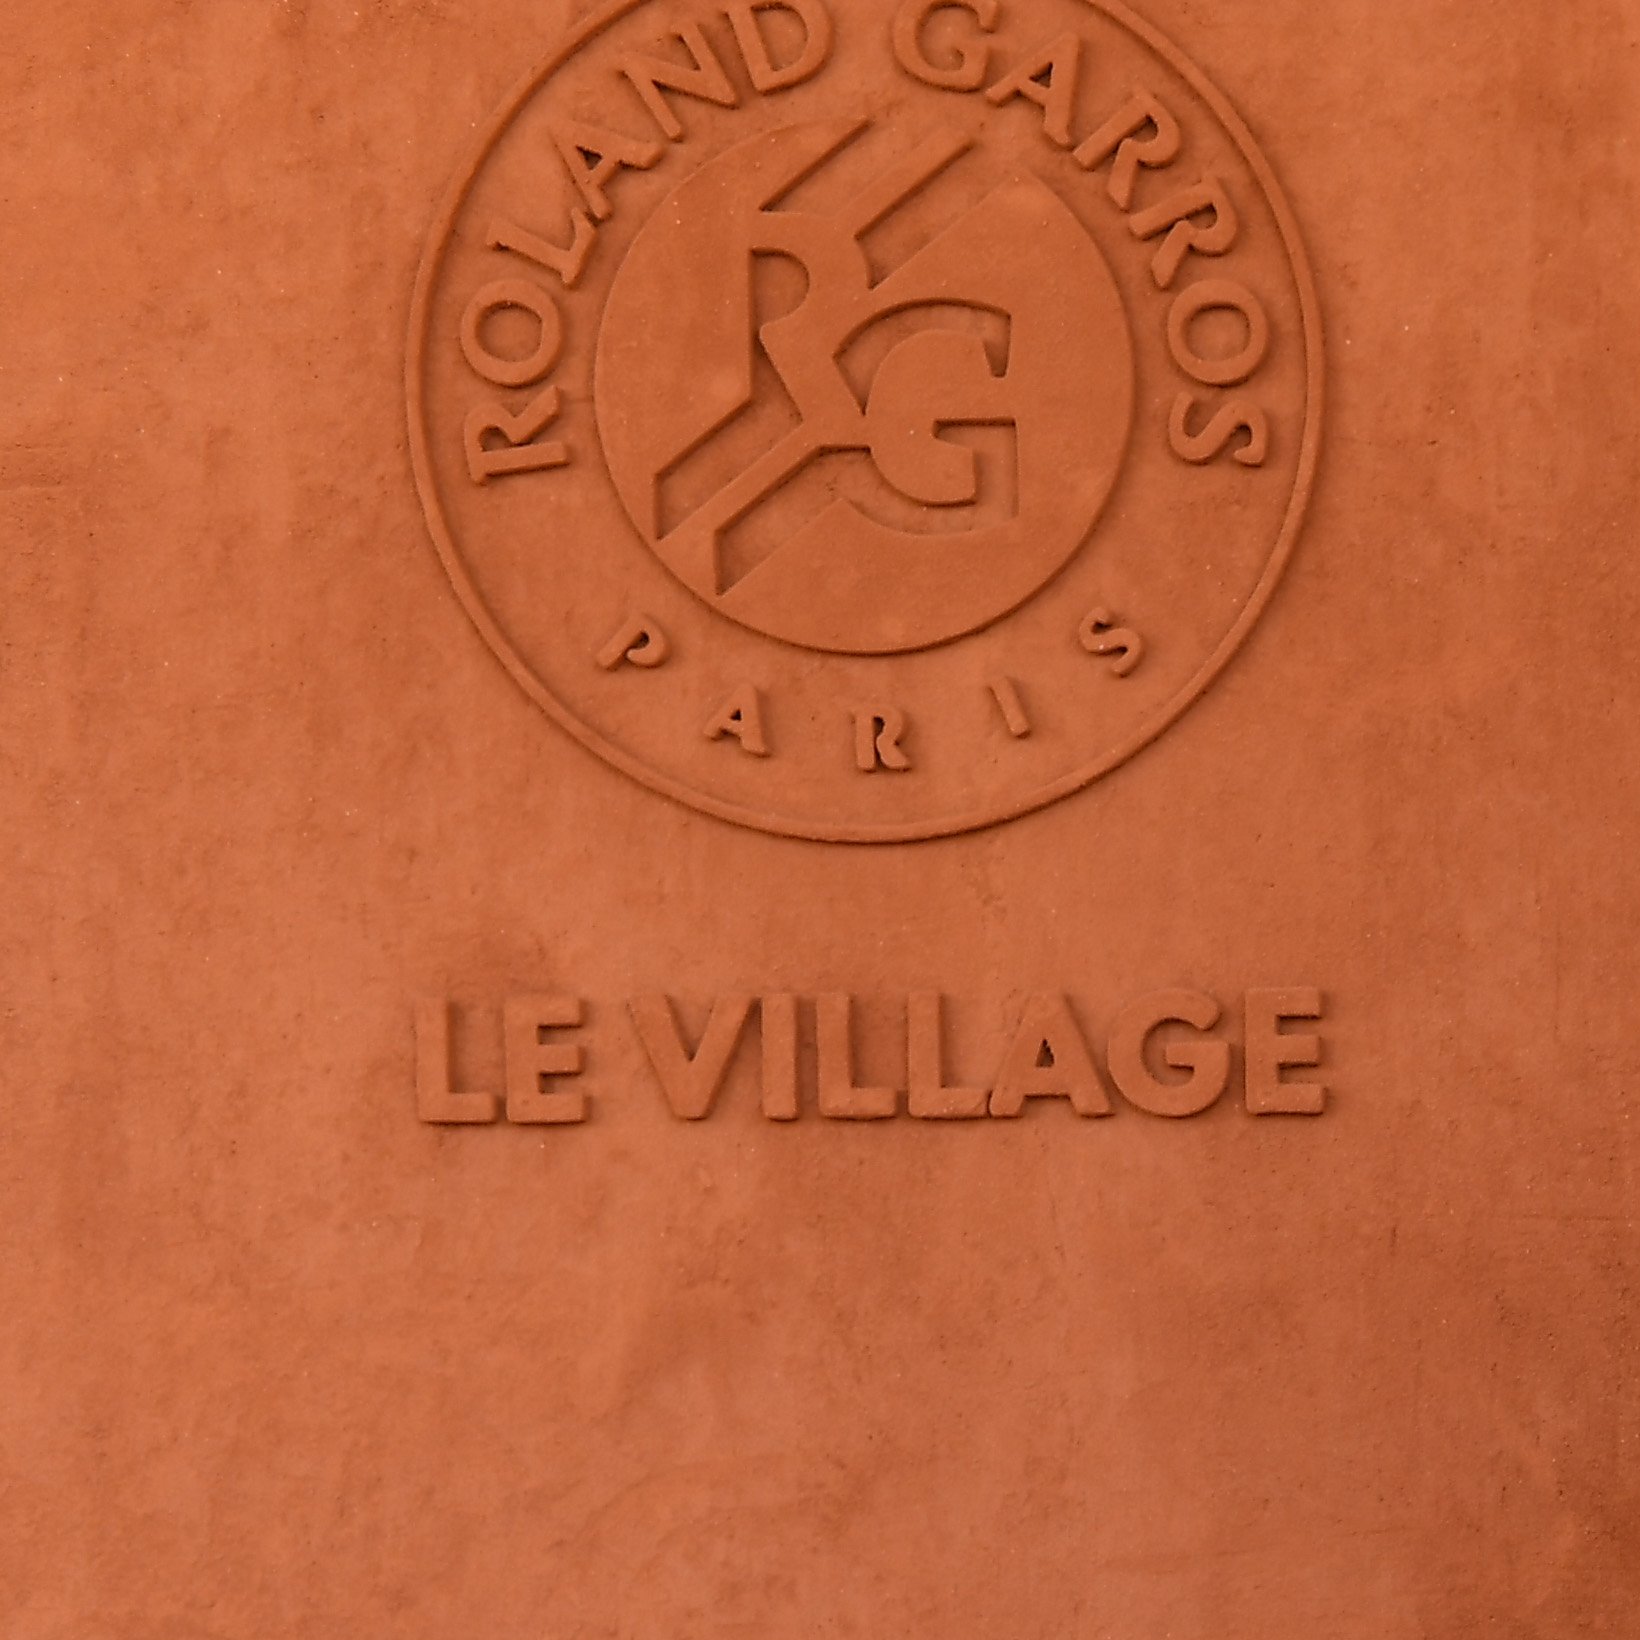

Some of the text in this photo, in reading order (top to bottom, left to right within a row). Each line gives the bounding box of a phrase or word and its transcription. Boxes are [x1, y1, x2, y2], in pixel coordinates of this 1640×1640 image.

[462, 0, 1271, 484] ROLAND GARROS
[601, 604, 1145, 774] PARIS
[413, 985, 1332, 1127] LE VILLAGE
